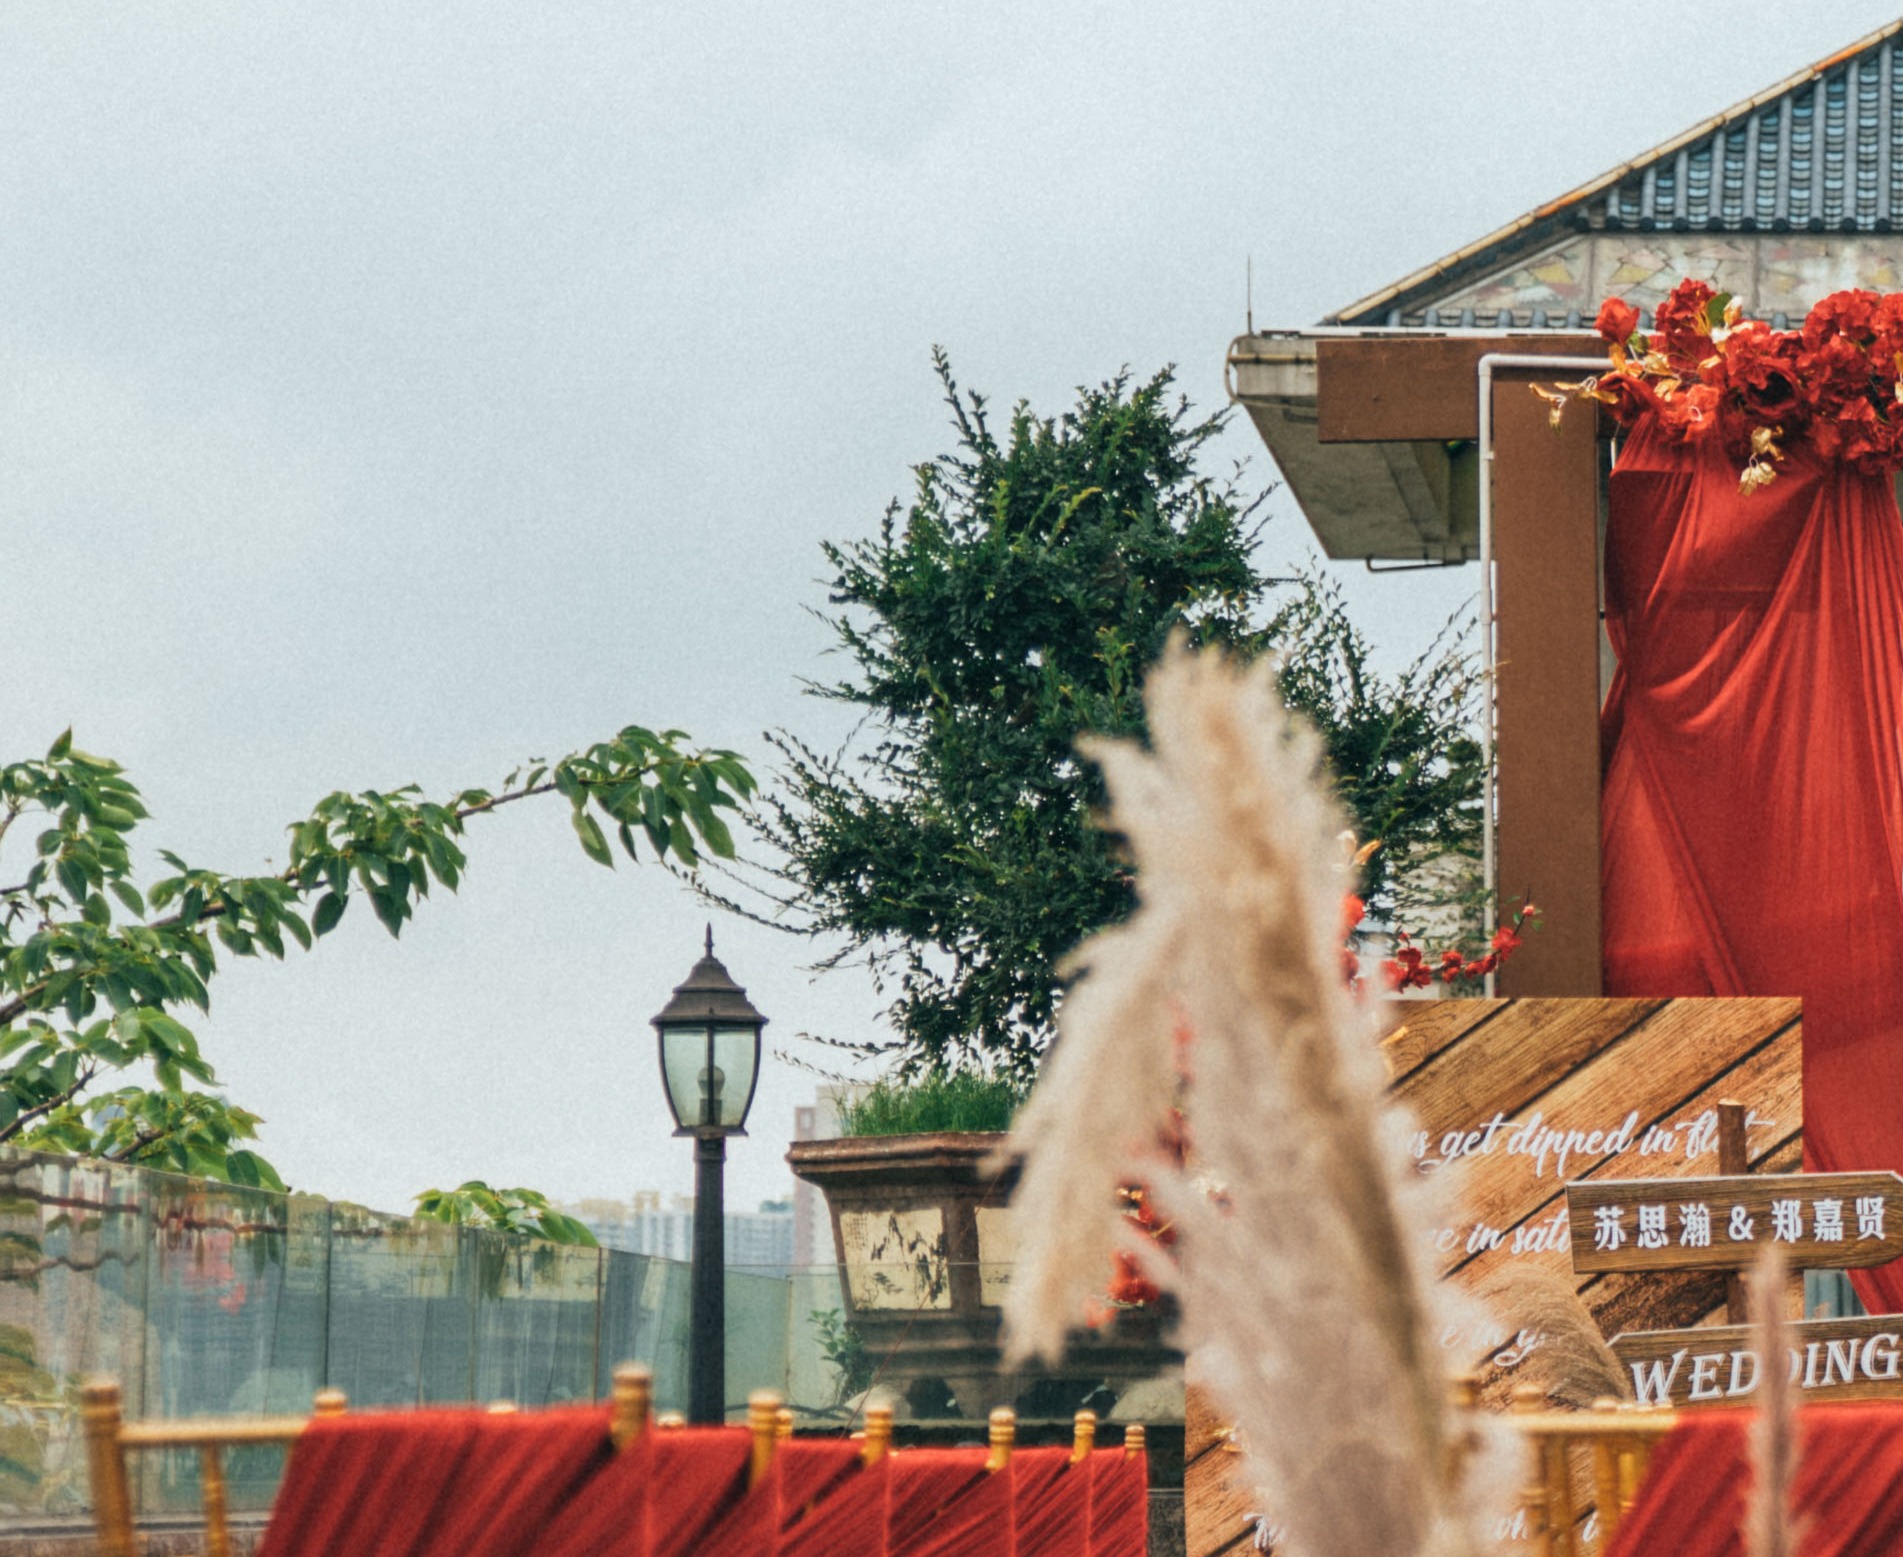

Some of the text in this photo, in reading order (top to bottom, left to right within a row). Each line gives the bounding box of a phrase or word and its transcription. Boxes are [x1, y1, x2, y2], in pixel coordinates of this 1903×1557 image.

[1418, 1111, 1522, 1175] get
[1506, 1111, 1639, 1179] dipped
[1640, 1123, 1679, 1158] in
[1466, 1222, 1507, 1254] in
[1593, 1196, 1887, 1250] 苏思瀚 & 郑嘉贤
